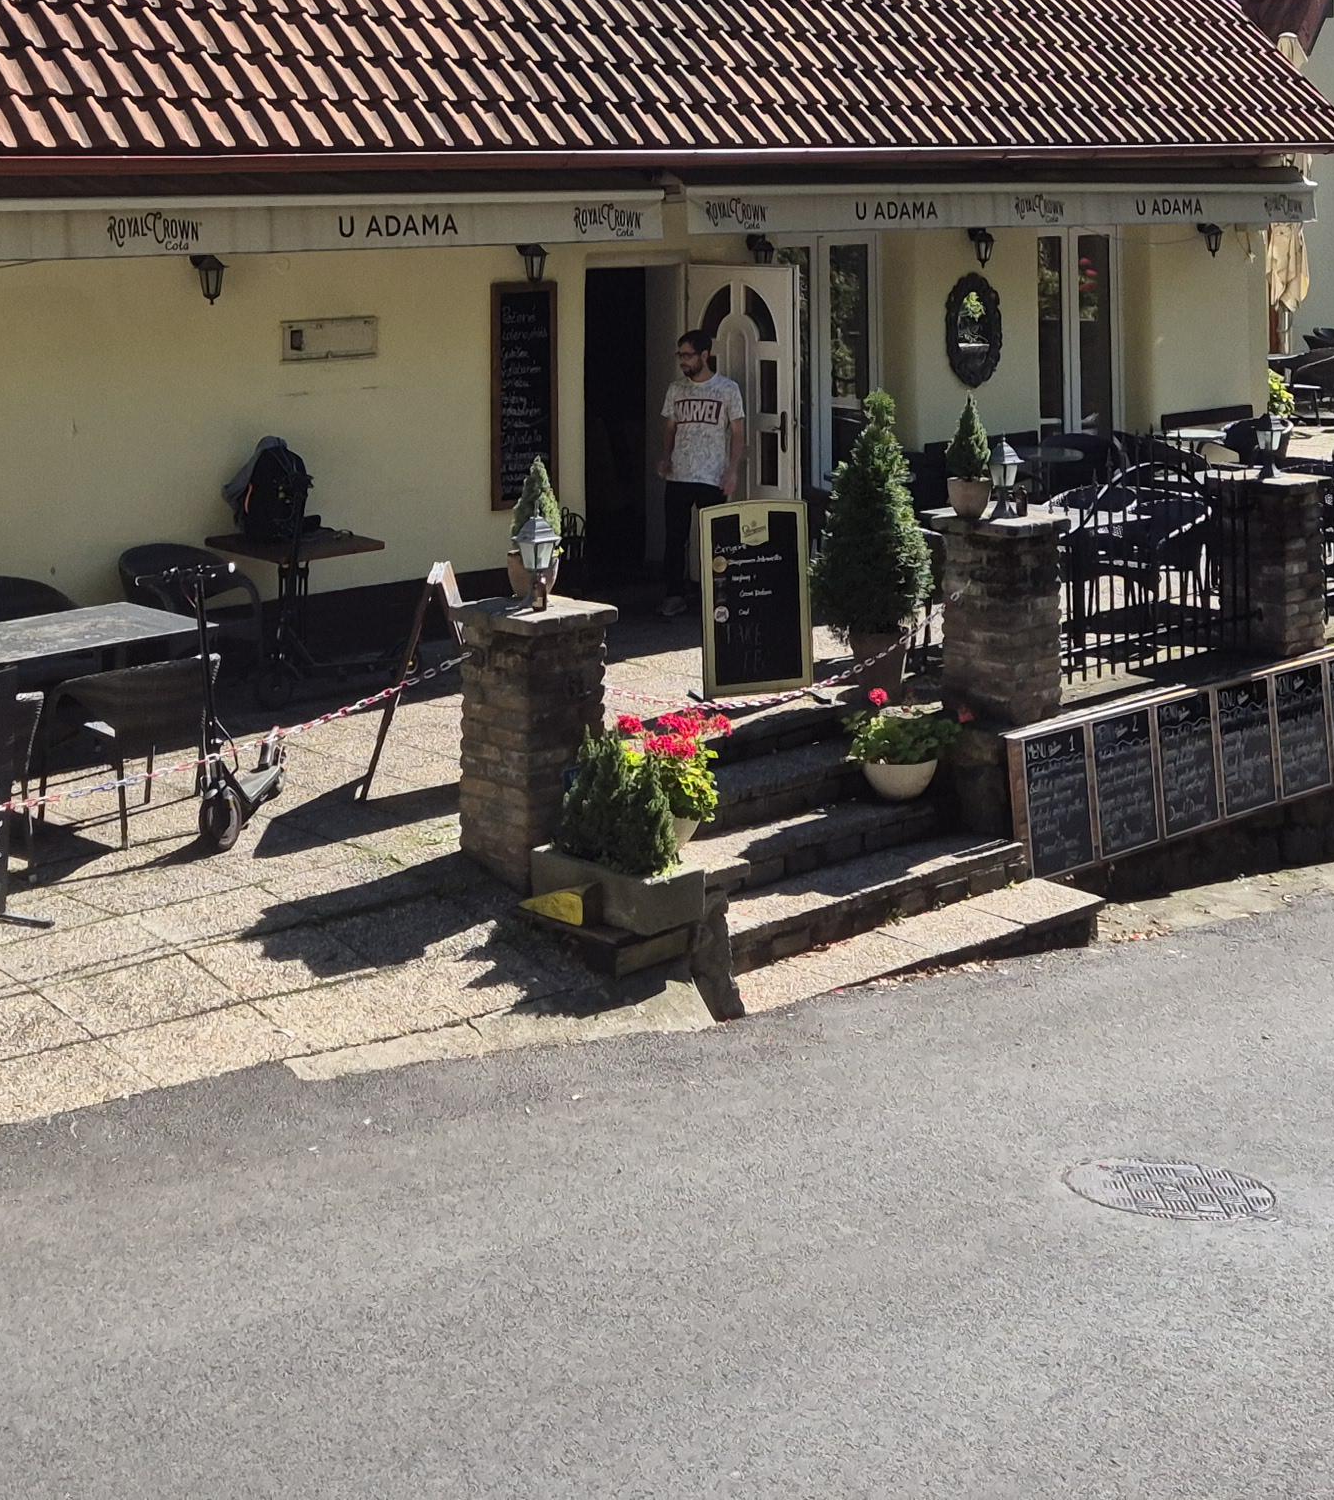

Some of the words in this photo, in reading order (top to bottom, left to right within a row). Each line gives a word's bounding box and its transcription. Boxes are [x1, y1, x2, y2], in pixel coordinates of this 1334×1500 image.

[705, 200, 731, 227] ROYAL
[728, 197, 767, 224] CROWN
[855, 201, 867, 220] U
[874, 200, 938, 220] ADAMA
[1136, 199, 1146, 216] U
[1151, 198, 1204, 216] ADAMA
[338, 215, 355, 238] U
[365, 213, 458, 238] ADAMA
[573, 206, 603, 234] ROYAL
[601, 203, 642, 231] CROWN
[107, 216, 148, 248] ROYAL
[145, 211, 199, 244] CROWN
[616, 228, 634, 237] Cola
[165, 241, 189, 251] Cola
[675, 400, 720, 422] MARVEL
[1068, 733, 1076, 752] 1
